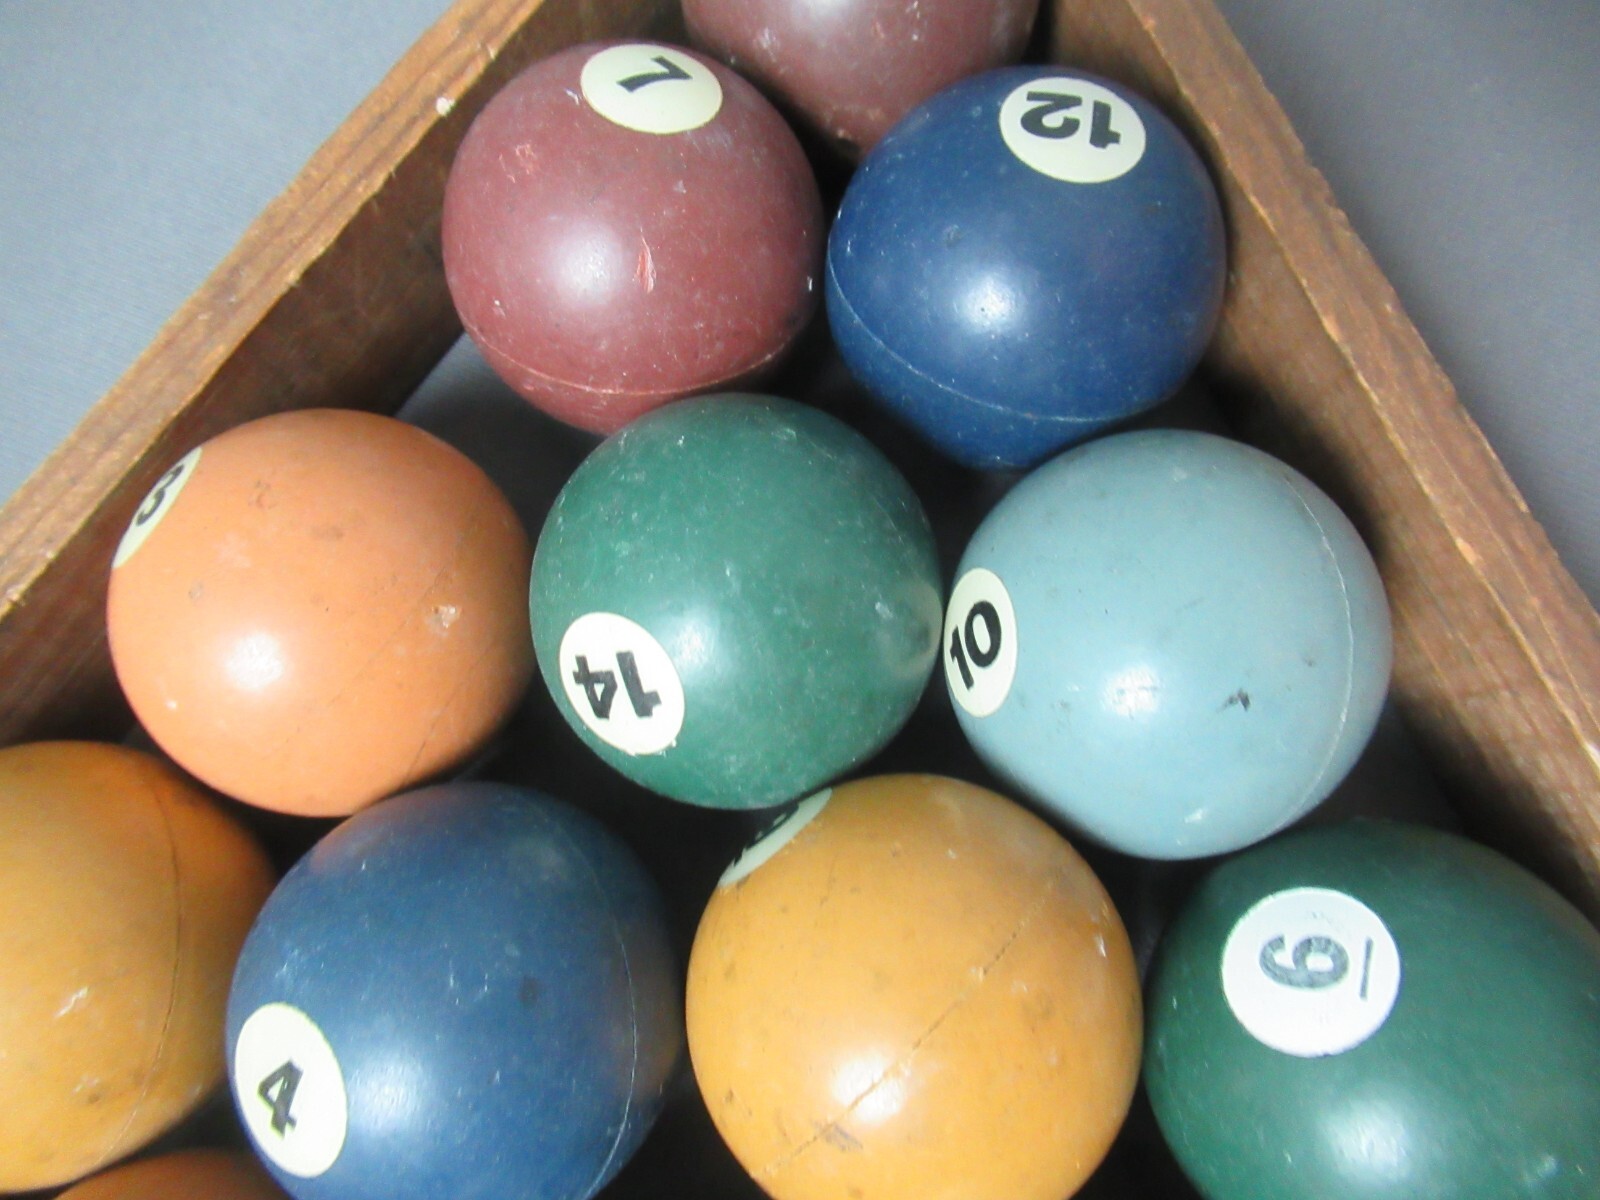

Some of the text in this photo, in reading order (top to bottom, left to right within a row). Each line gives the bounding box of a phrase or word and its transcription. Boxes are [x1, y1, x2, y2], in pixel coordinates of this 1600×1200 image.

[616, 55, 693, 93] 7
[1020, 91, 1121, 149] 12
[950, 600, 1003, 690] 10
[573, 651, 662, 719] 14
[1259, 934, 1349, 988] 6
[257, 1058, 304, 1139] 4
